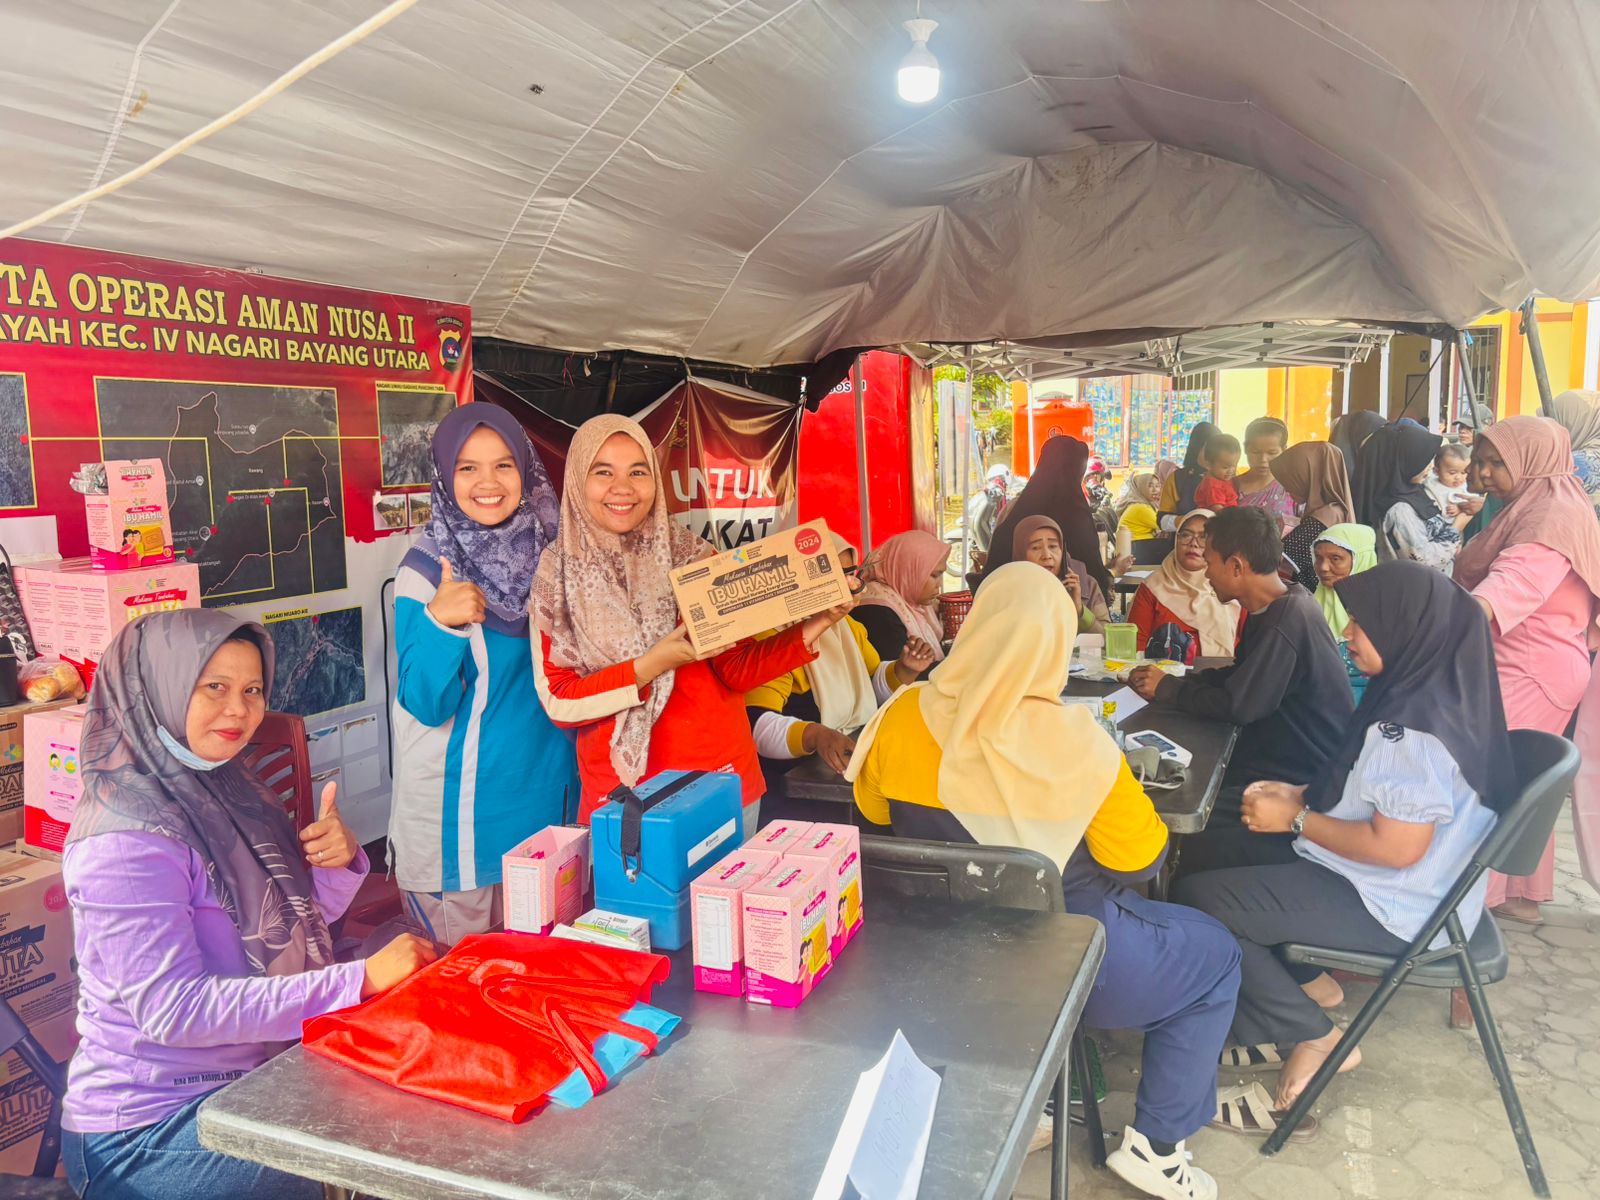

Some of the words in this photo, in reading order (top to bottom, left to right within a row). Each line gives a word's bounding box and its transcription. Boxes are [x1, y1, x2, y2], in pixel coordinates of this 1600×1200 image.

[0, 263, 58, 309] TA
[68, 272, 228, 326] OPERASI
[237, 294, 319, 335] AMAN
[327, 305, 393, 342] NUSA
[398, 315, 416, 345] II
[80, 320, 147, 350] KEC.
[153, 327, 179, 352] IV
[186, 330, 281, 361] NAGARI
[286, 340, 369, 367] BAYANG
[373, 347, 432, 371] UTARA
[670, 467, 776, 503] UNTUK
[688, 517, 774, 551] AKAT
[797, 536, 820, 550] 2024
[707, 580, 739, 606] IBU
[740, 564, 797, 595] HAMIL
